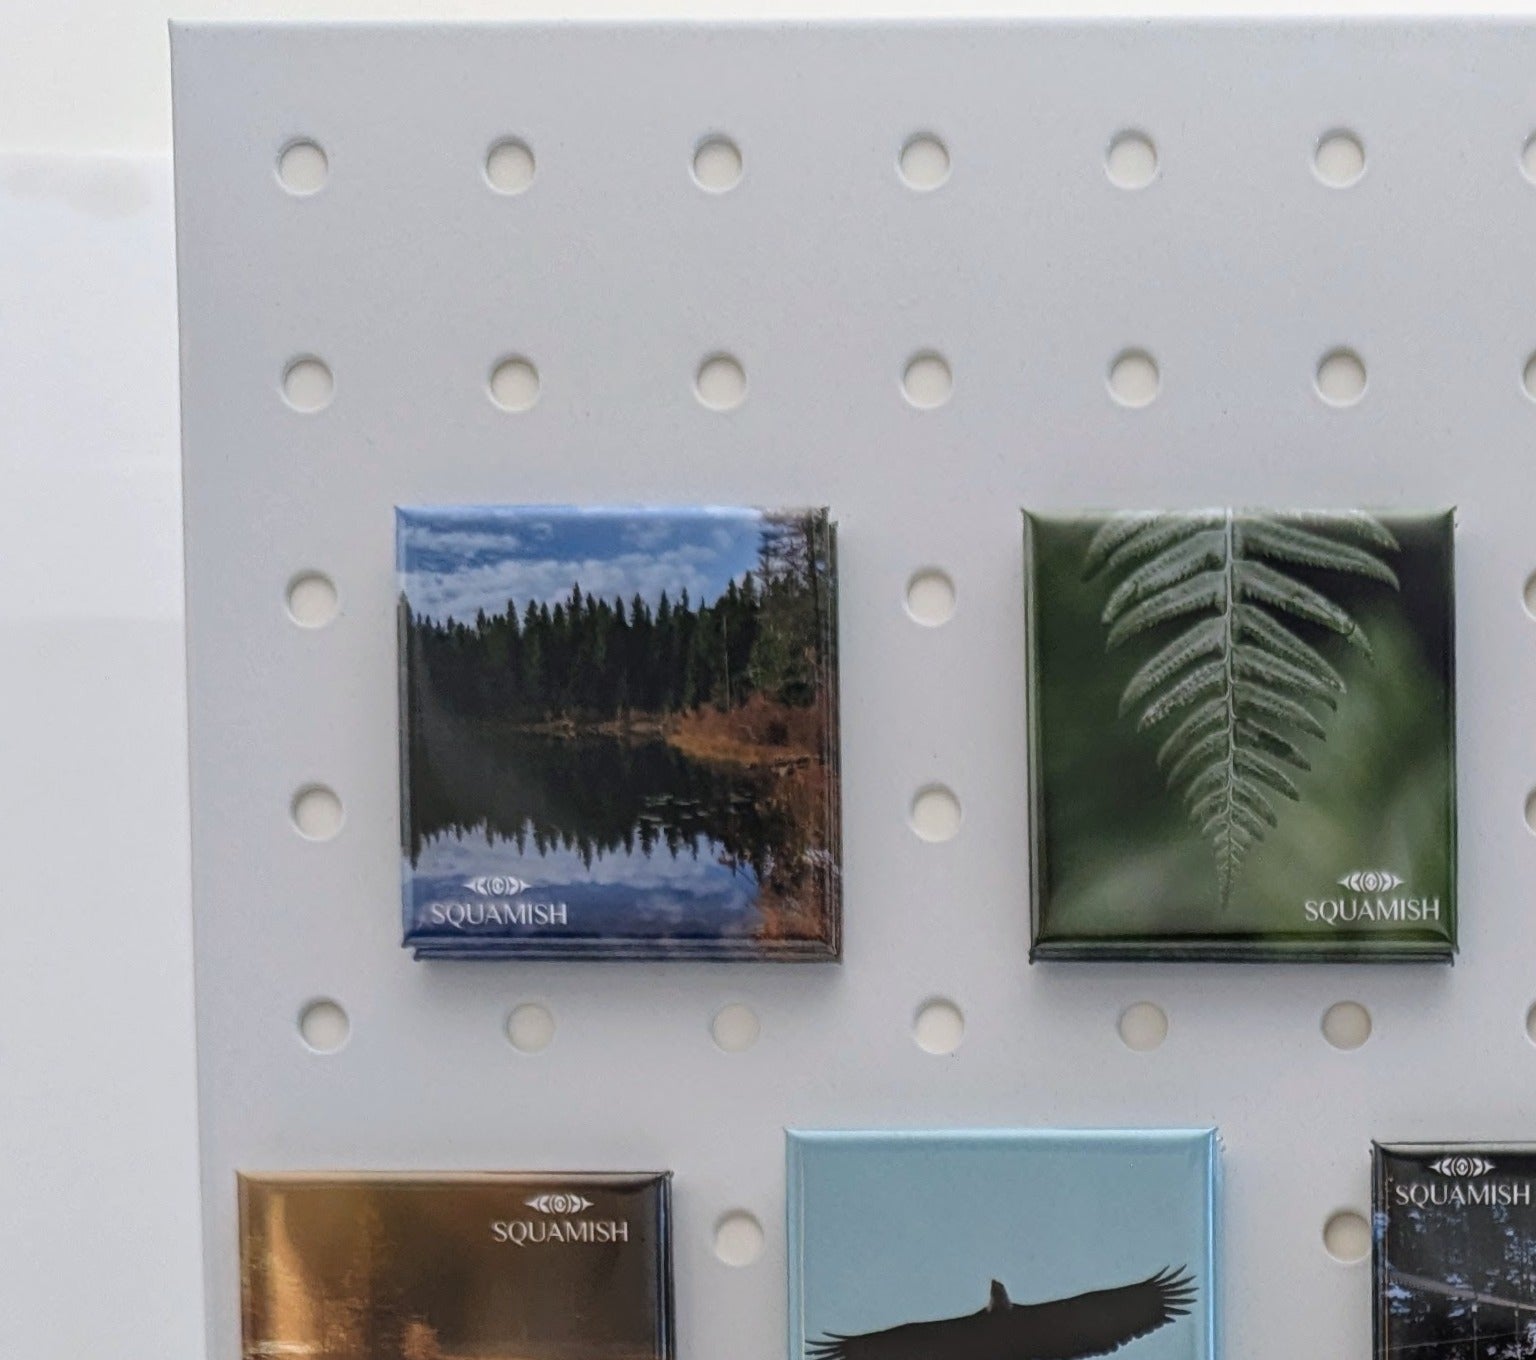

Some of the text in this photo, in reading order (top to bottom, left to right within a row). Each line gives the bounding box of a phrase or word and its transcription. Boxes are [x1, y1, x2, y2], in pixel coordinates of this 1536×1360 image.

[430, 902, 568, 928] SQUAMISH
[1304, 897, 1441, 925] SQUAMISH
[1395, 1183, 1530, 1209] SQUAMISH
[491, 1221, 629, 1248] SQUAMISH
